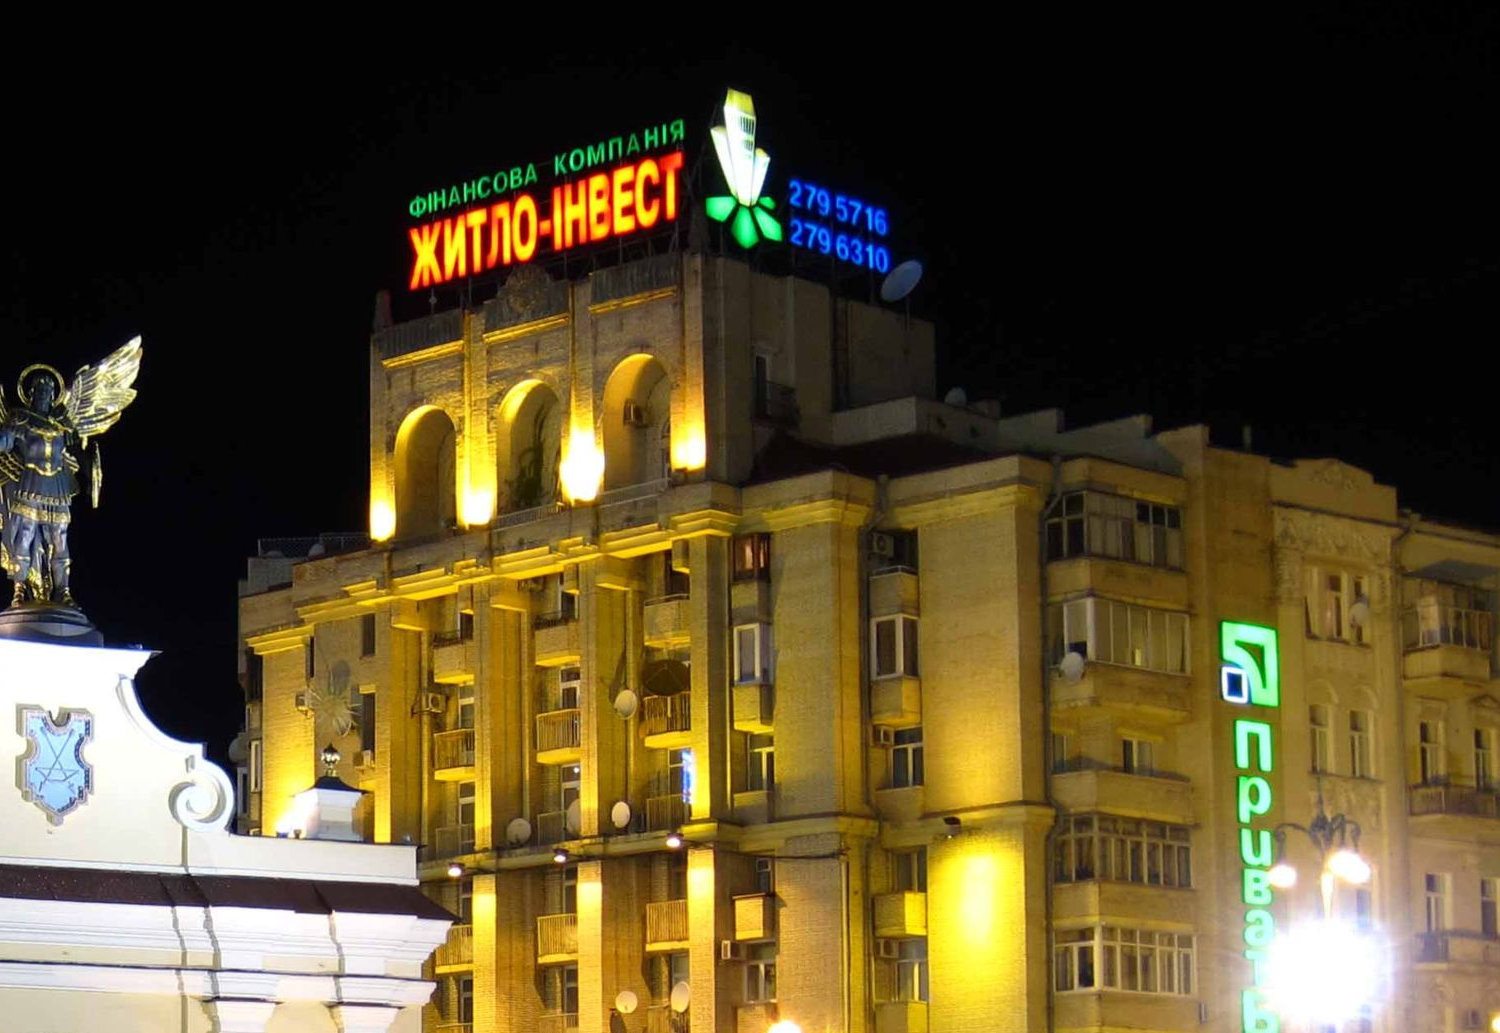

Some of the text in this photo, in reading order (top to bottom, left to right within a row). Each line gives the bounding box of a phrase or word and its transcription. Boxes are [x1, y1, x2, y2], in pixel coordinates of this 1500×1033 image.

[408, 119, 686, 218] ФІНАНСОВА КОМПАНІЯ
[408, 151, 684, 290] ЖИТЛО-ІНВЕСТ
